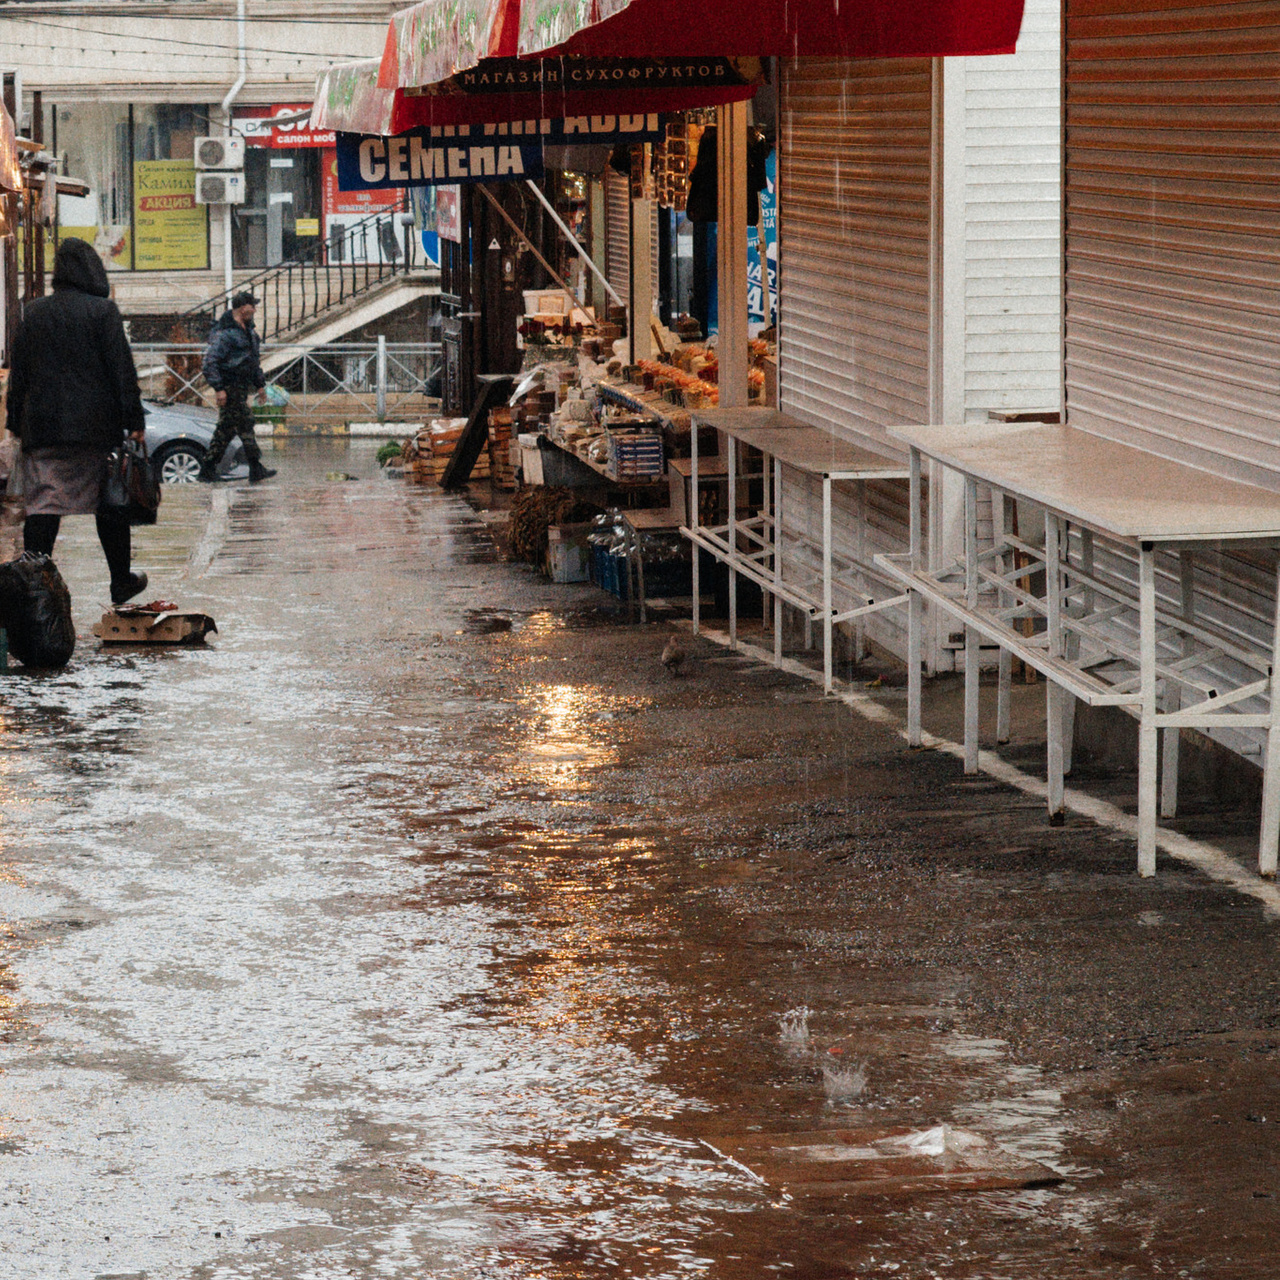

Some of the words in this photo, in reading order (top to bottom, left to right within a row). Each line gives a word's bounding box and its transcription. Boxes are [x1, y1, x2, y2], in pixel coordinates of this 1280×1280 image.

[464, 70, 558, 85] МАГАЗИН
[571, 65, 725, 81] СУХОФРУКТОВ
[277, 135, 311, 144] салон
[359, 137, 525, 183] СЕМЕНА
[145, 196, 192, 210] АКЦИЯ
